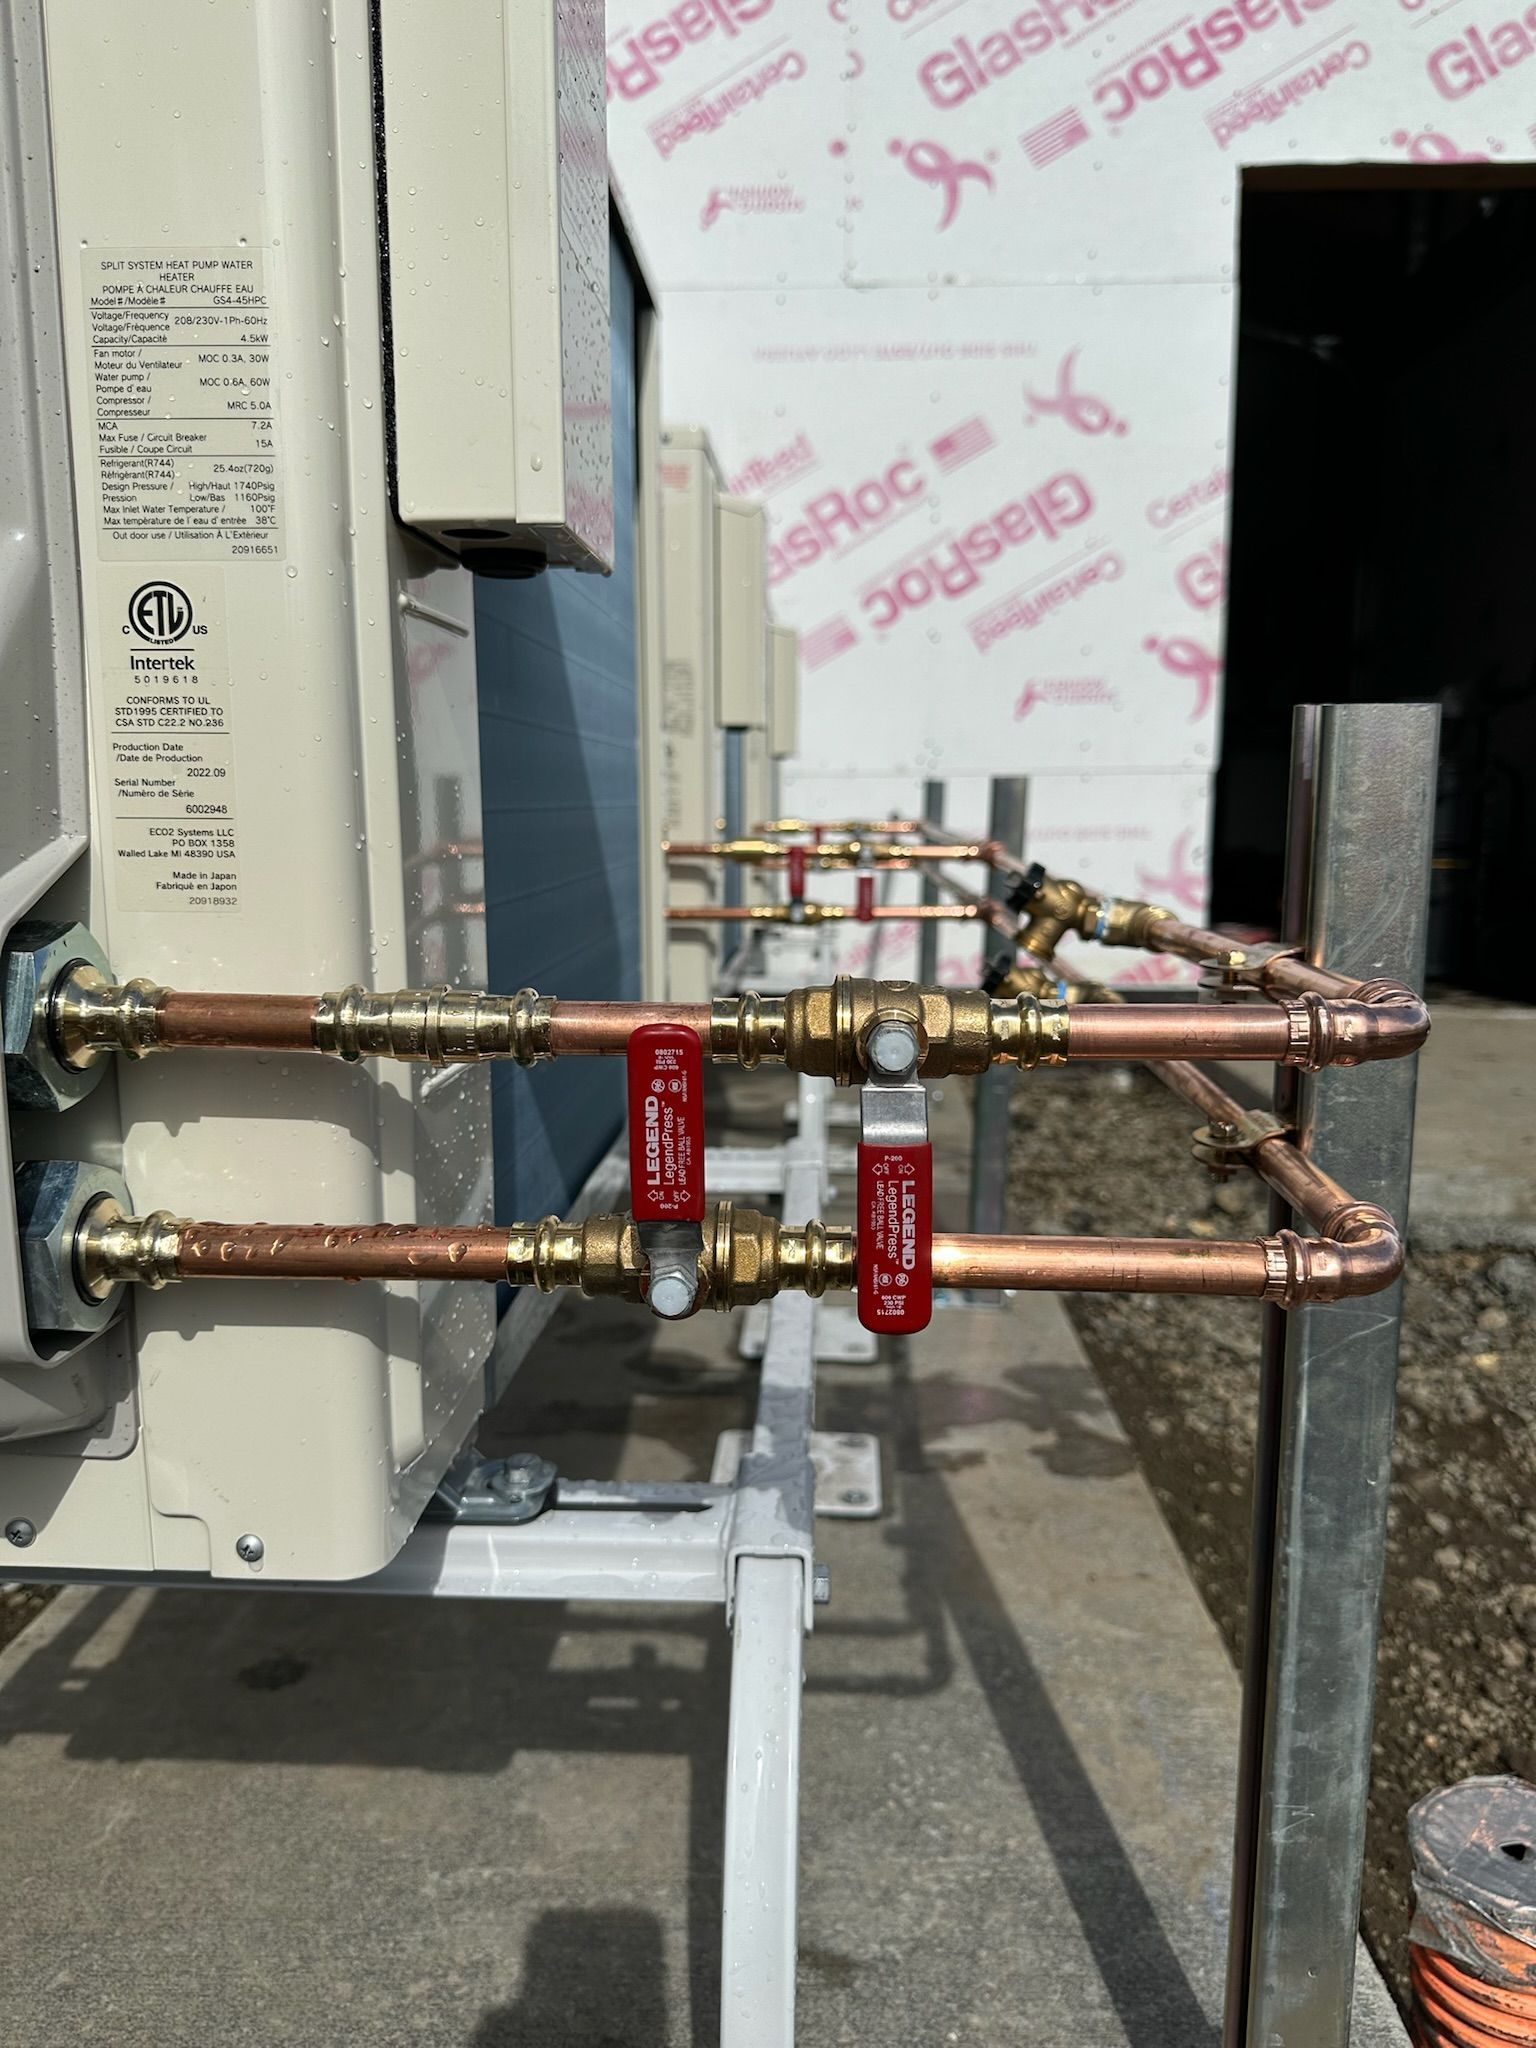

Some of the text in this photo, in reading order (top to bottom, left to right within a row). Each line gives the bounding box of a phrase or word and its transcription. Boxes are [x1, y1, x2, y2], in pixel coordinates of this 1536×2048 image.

[101, 261, 253, 270] SPLIT SYSTEM HEAT PUMP WATER
[160, 273, 194, 281] HEATER
[146, 285, 188, 293] CHALEUR
[191, 285, 232, 293] CHAUFFE
[236, 285, 253, 293] EAU
[213, 297, 266, 305] GS4-45HPC
[91, 311, 169, 321] Voltage/Frequency
[249, 354, 269, 362] 30W
[126, 361, 136, 369] du
[139, 361, 182, 369] Ventilateur
[95, 373, 144, 383] Water pump
[200, 378, 220, 386] MOC
[250, 378, 270, 386] 60W
[96, 385, 124, 395] Pompe
[97, 396, 144, 406] Compressor
[251, 401, 271, 409] 5.0A
[98, 409, 150, 418] Compresseur
[98, 422, 272, 430] MCA 7.2A
[176, 433, 206, 441] Breaker
[100, 445, 192, 455] Fusible Coupe Circuit
[102, 483, 129, 492] Design
[143, 505, 165, 513] Water
[168, 505, 219, 515] Temperature
[105, 517, 121, 525] Max
[175, 517, 184, 525] de
[113, 532, 127, 540] Out
[132, 531, 148, 539] door
[175, 531, 214, 539] Utilisation
[860, 470, 1094, 628] GlasRoc
[193, 626, 207, 634] US
[131, 656, 195, 670] Intertek
[187, 768, 226, 777] 2022.09
[186, 805, 227, 813] 6002948
[178, 829, 213, 837] Systems
[211, 872, 236, 881] Japan
[211, 883, 237, 892] Japon
[190, 897, 237, 905] 20918932
[677, 1116, 685, 1135] VALVE
[645, 1096, 660, 1185] LEGEND
[678, 1136, 686, 1151] BALL
[678, 1152, 686, 1168] FREE
[902, 1180, 915, 1270] LEGEND
